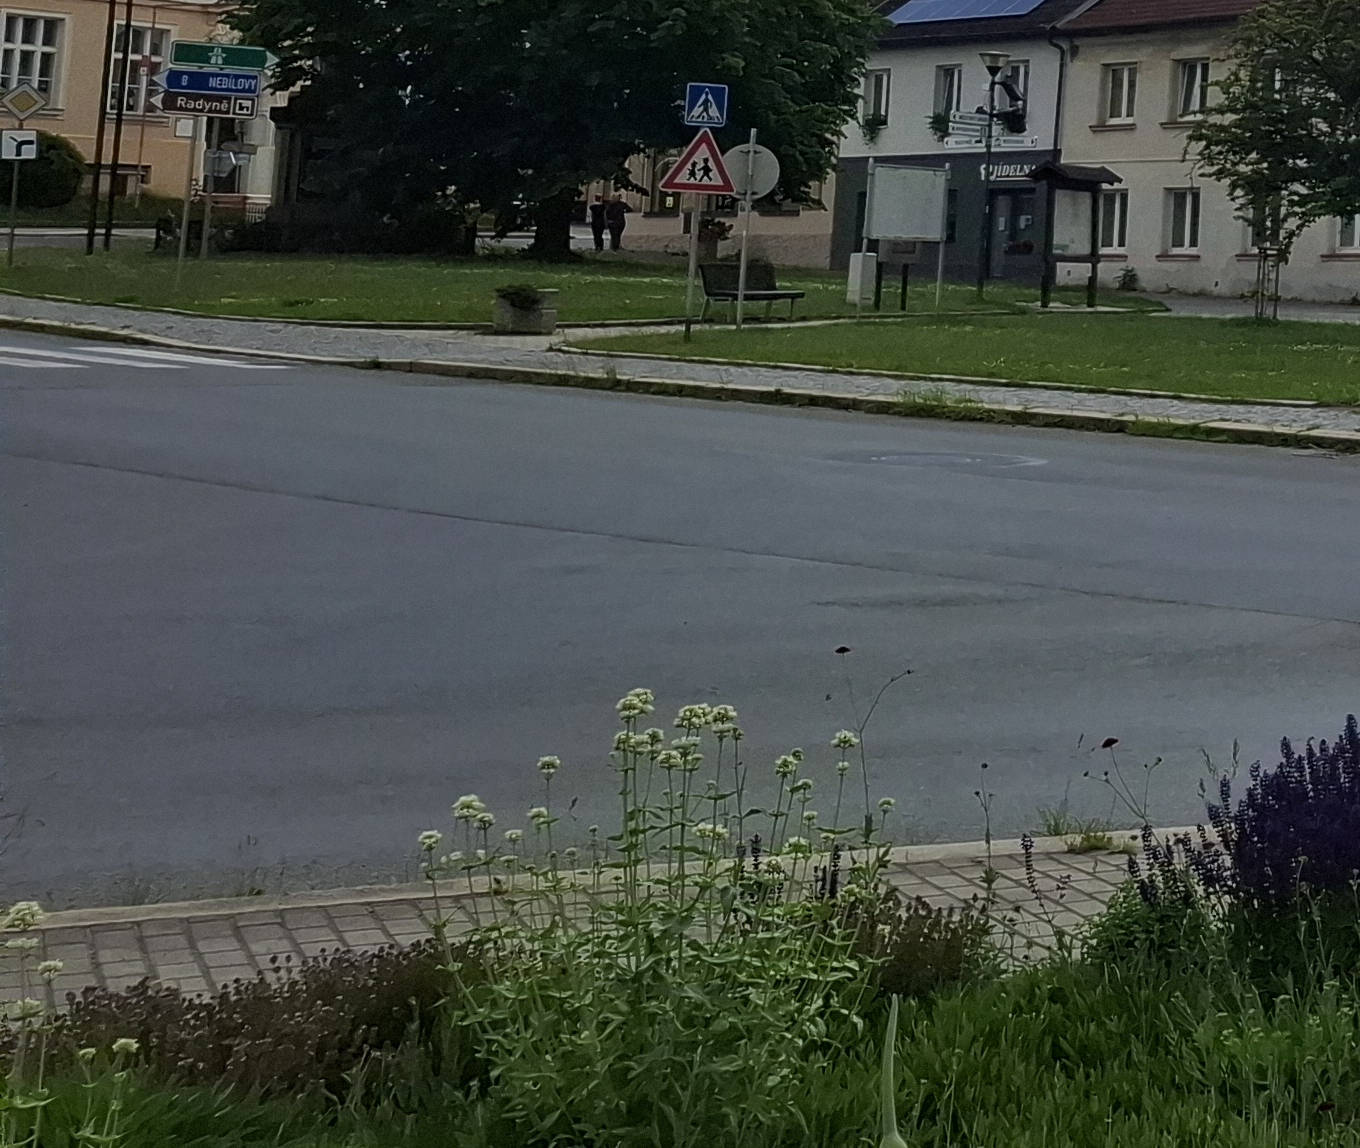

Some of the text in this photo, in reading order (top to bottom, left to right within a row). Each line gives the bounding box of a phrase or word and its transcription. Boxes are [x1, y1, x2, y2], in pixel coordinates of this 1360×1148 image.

[208, 75, 257, 90] NEBÍLOVY
[177, 96, 229, 112] Radyně
[989, 161, 1037, 181] JÍDELN
